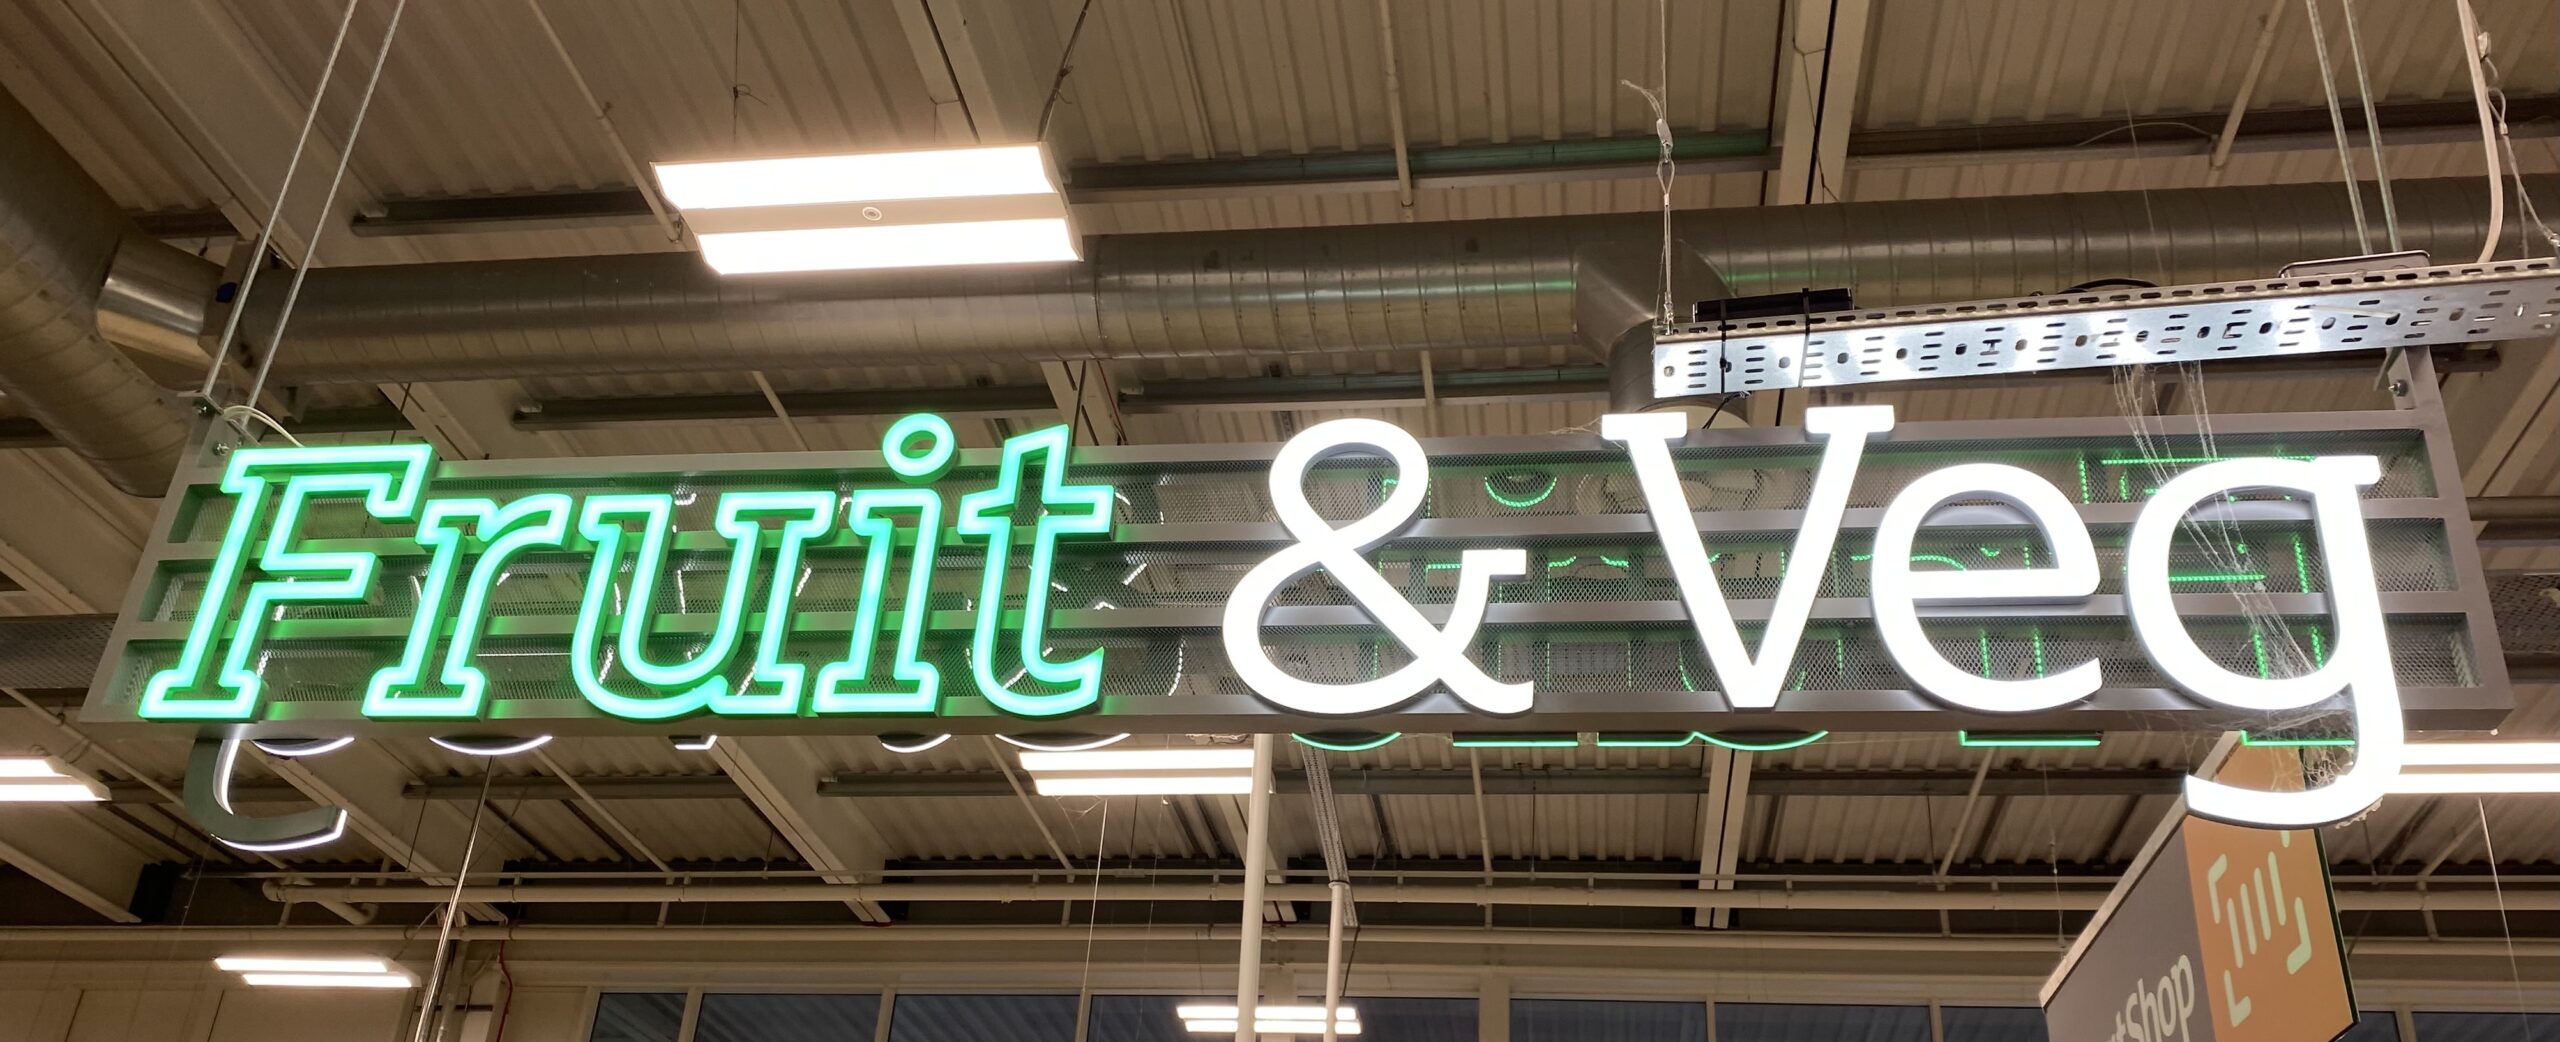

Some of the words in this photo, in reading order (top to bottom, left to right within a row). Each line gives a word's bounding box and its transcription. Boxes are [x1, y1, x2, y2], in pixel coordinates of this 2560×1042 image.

[139, 413, 1116, 720] Fruit
[1223, 418, 1535, 715] &
[1600, 405, 2406, 827] Veg
